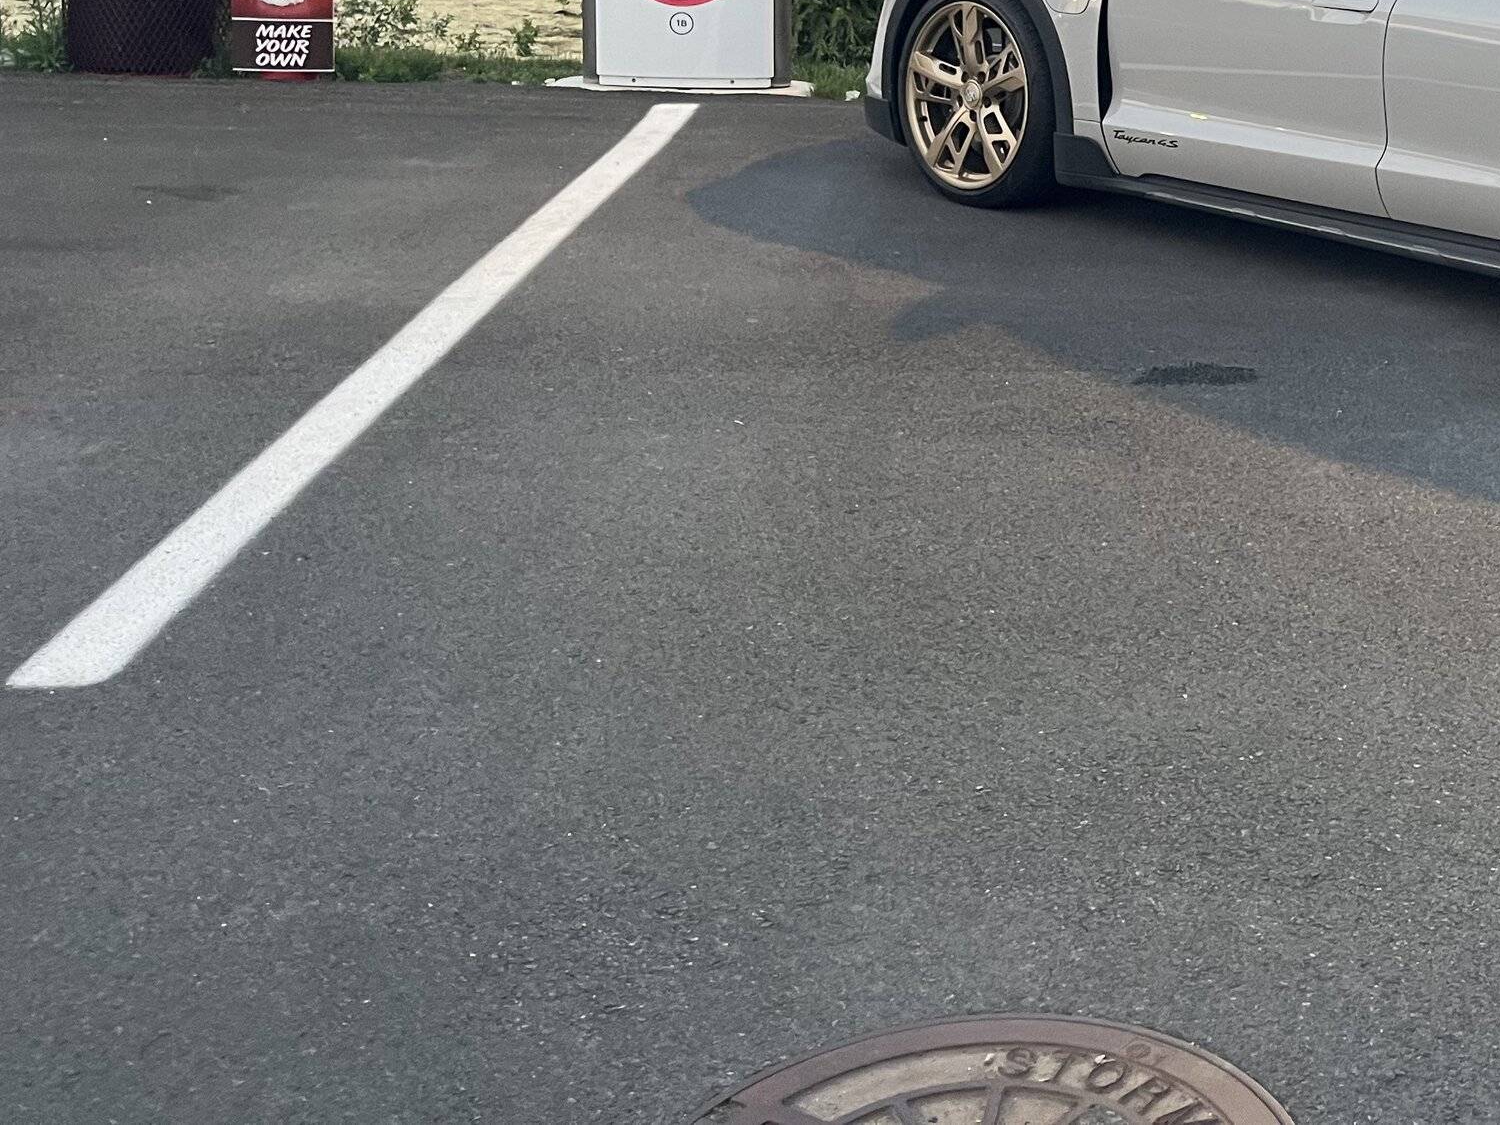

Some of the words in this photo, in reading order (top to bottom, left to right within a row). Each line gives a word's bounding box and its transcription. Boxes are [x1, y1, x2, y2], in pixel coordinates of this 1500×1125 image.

[255, 24, 312, 38] MAKE
[255, 38, 310, 54] YOUR
[255, 52, 307, 66] OWN
[1113, 130, 1156, 144] Taycan
